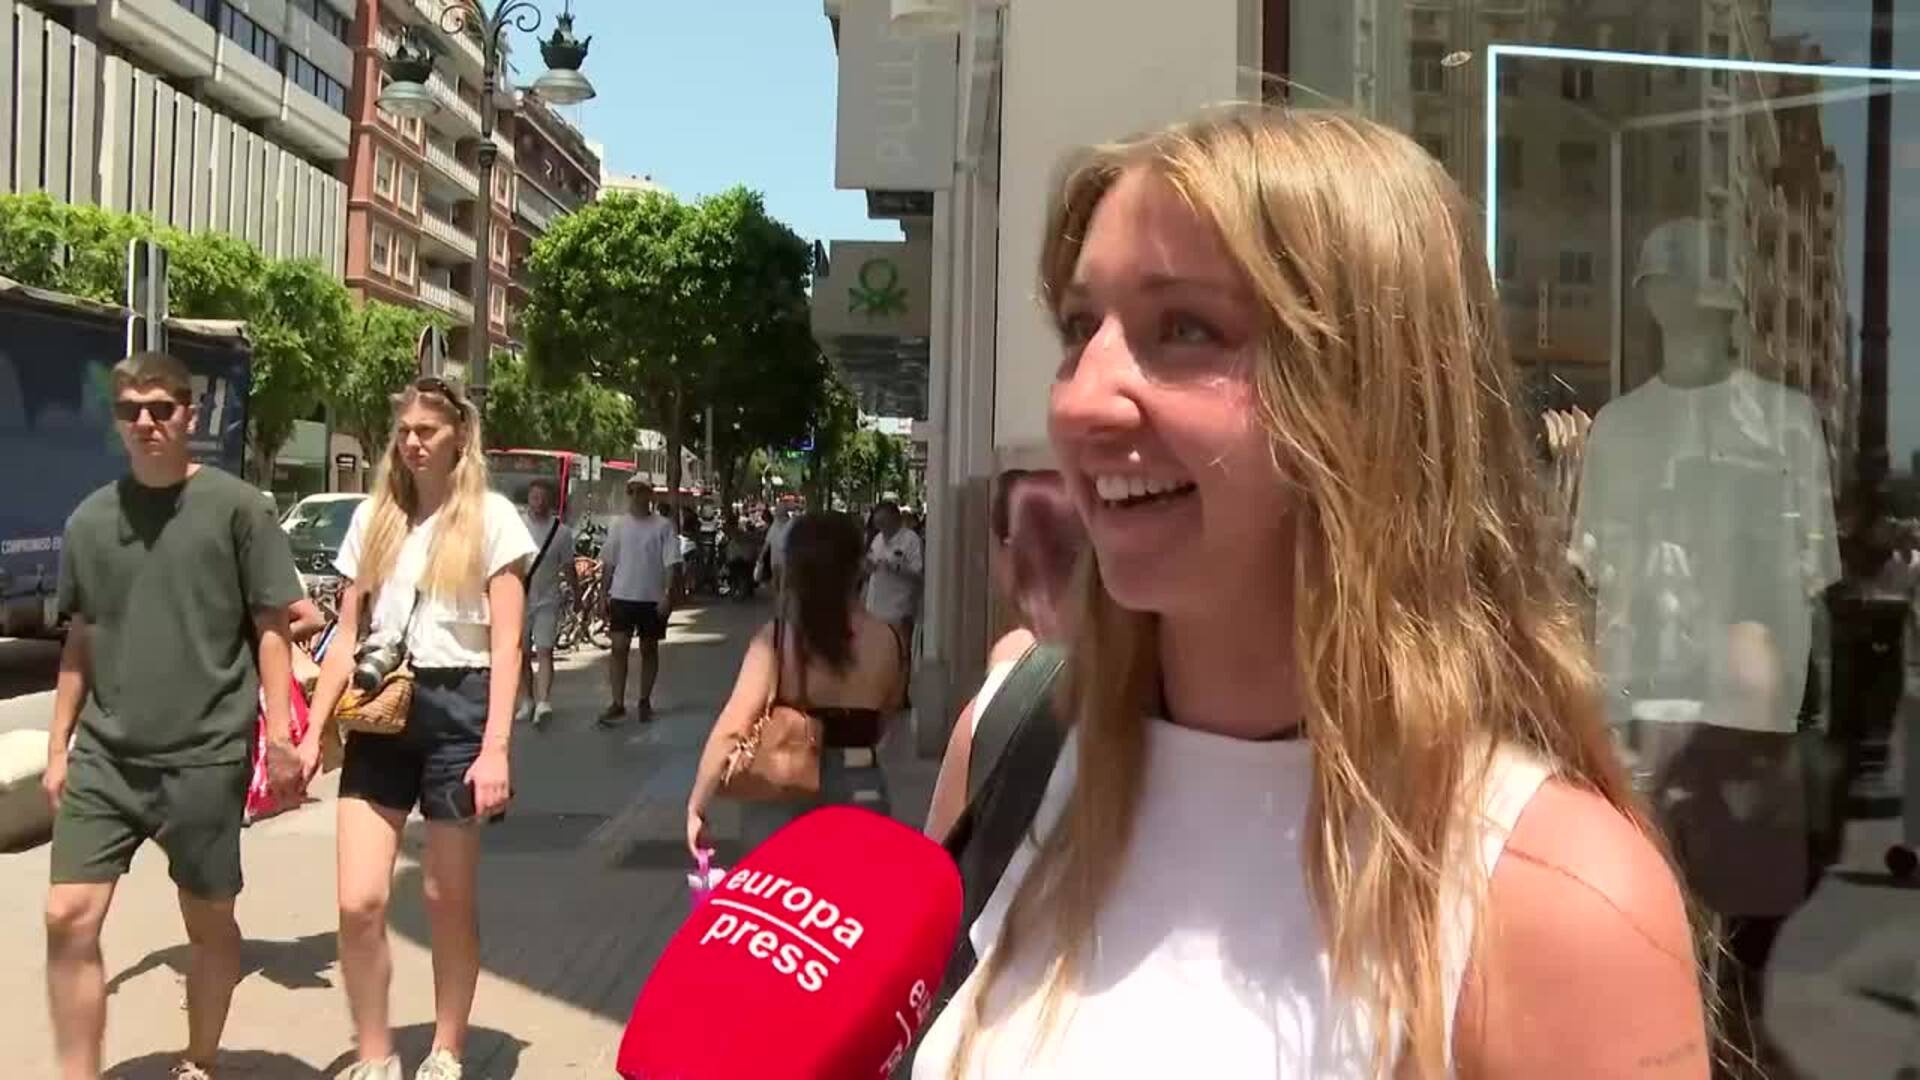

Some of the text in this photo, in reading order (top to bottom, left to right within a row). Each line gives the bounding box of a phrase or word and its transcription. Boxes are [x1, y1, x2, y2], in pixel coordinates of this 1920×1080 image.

[876, 47, 921, 166] PULL
[725, 868, 865, 950] europa
[699, 913, 829, 993] press
